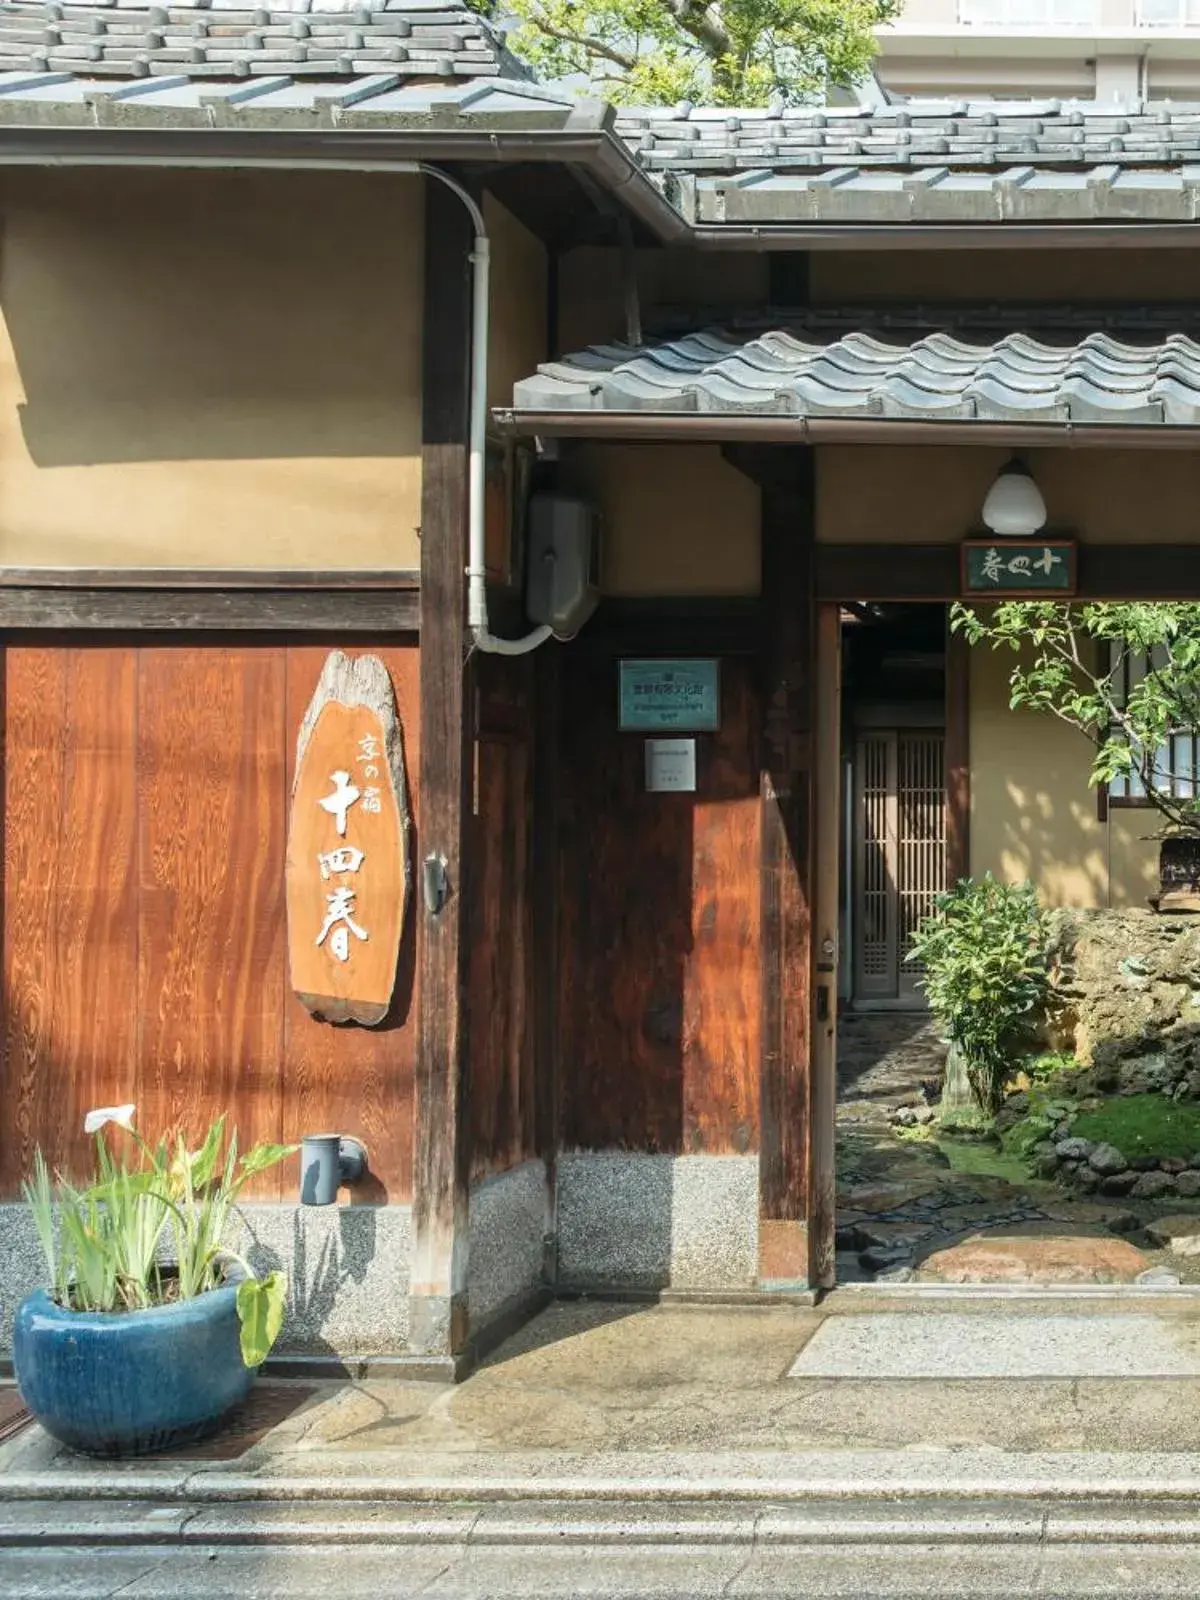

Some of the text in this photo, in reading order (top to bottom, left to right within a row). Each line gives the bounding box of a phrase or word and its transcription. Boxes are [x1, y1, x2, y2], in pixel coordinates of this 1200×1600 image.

[981, 547, 1061, 582] 十四春
[356, 734, 382, 815] 京の宿
[316, 769, 369, 962] 十四春
